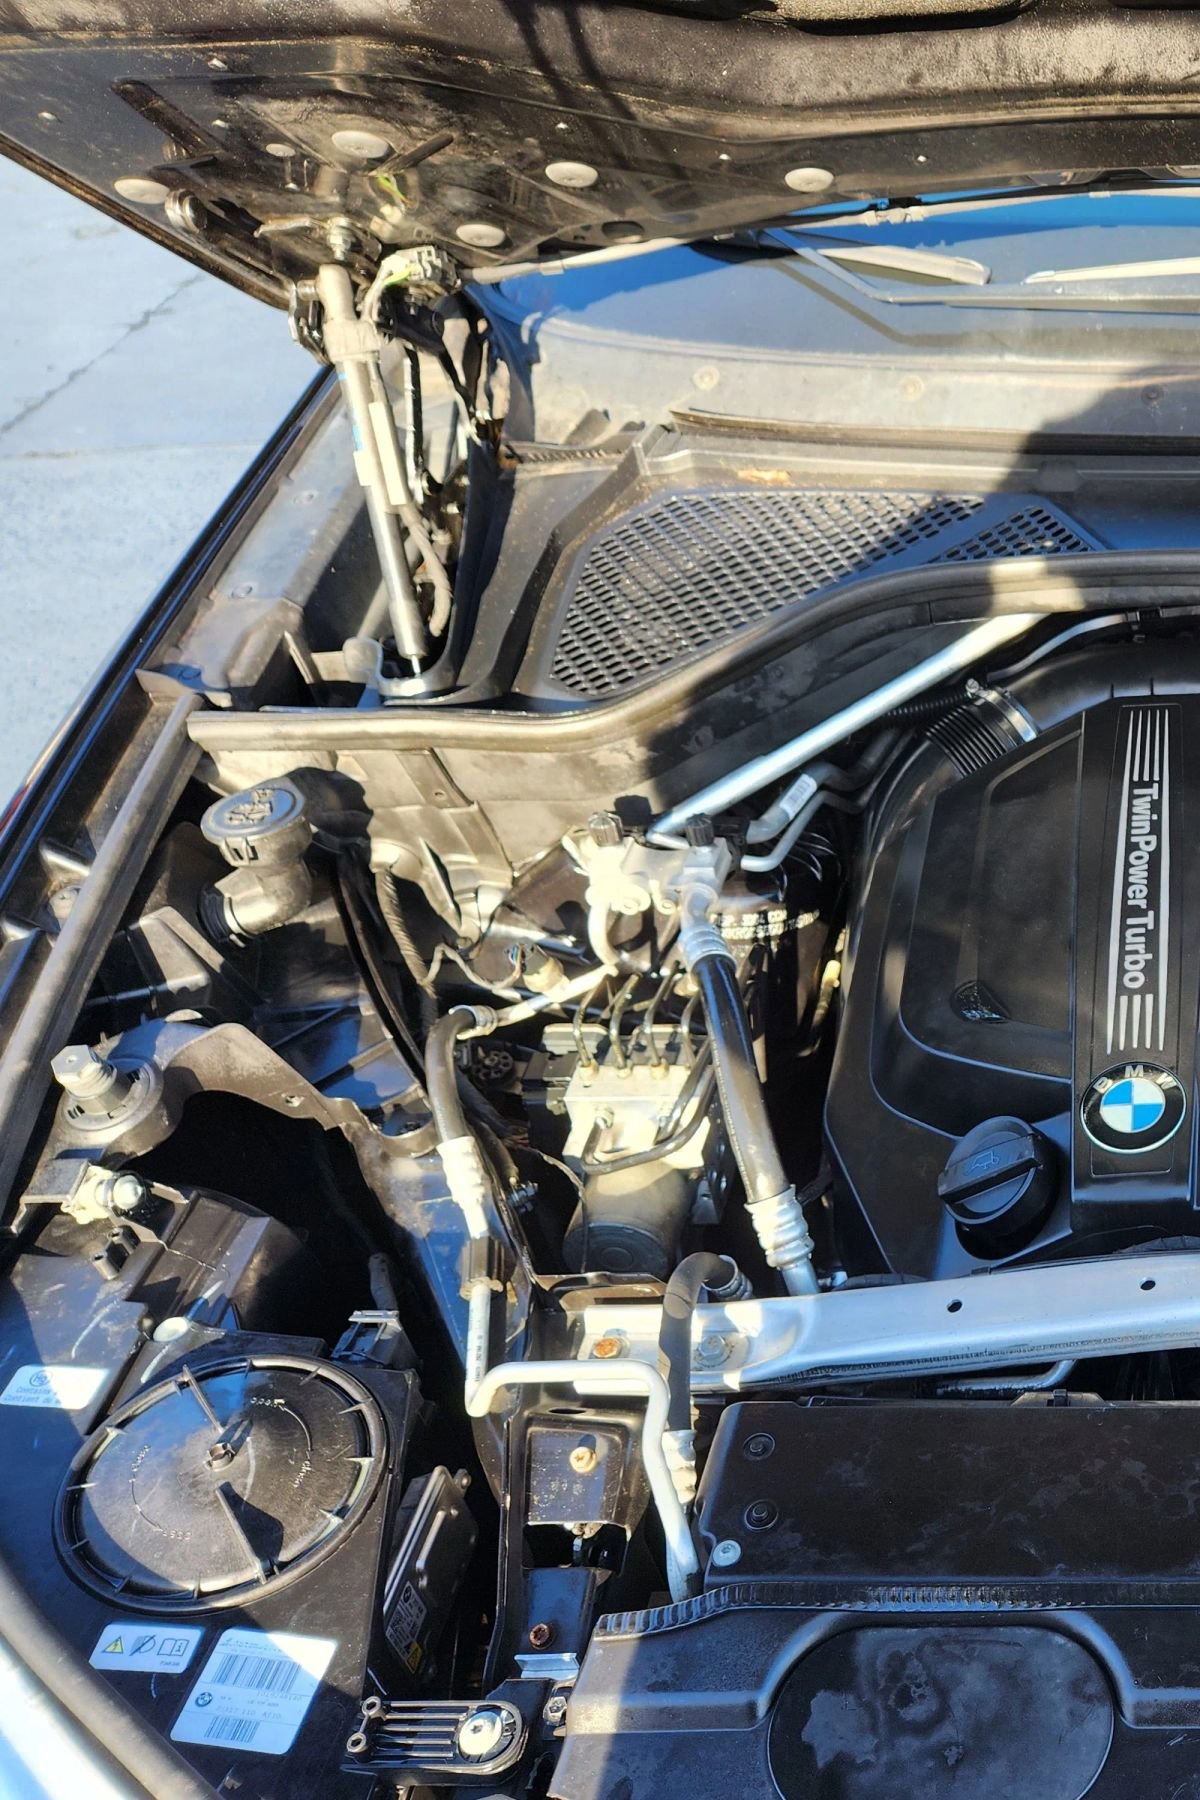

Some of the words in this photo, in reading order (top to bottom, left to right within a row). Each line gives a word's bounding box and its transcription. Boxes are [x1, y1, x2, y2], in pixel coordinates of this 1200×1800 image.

[1126, 781, 1159, 909] TwinPower
[1122, 911, 1155, 990] Turbo
[1093, 1065, 1177, 1094] BMW
